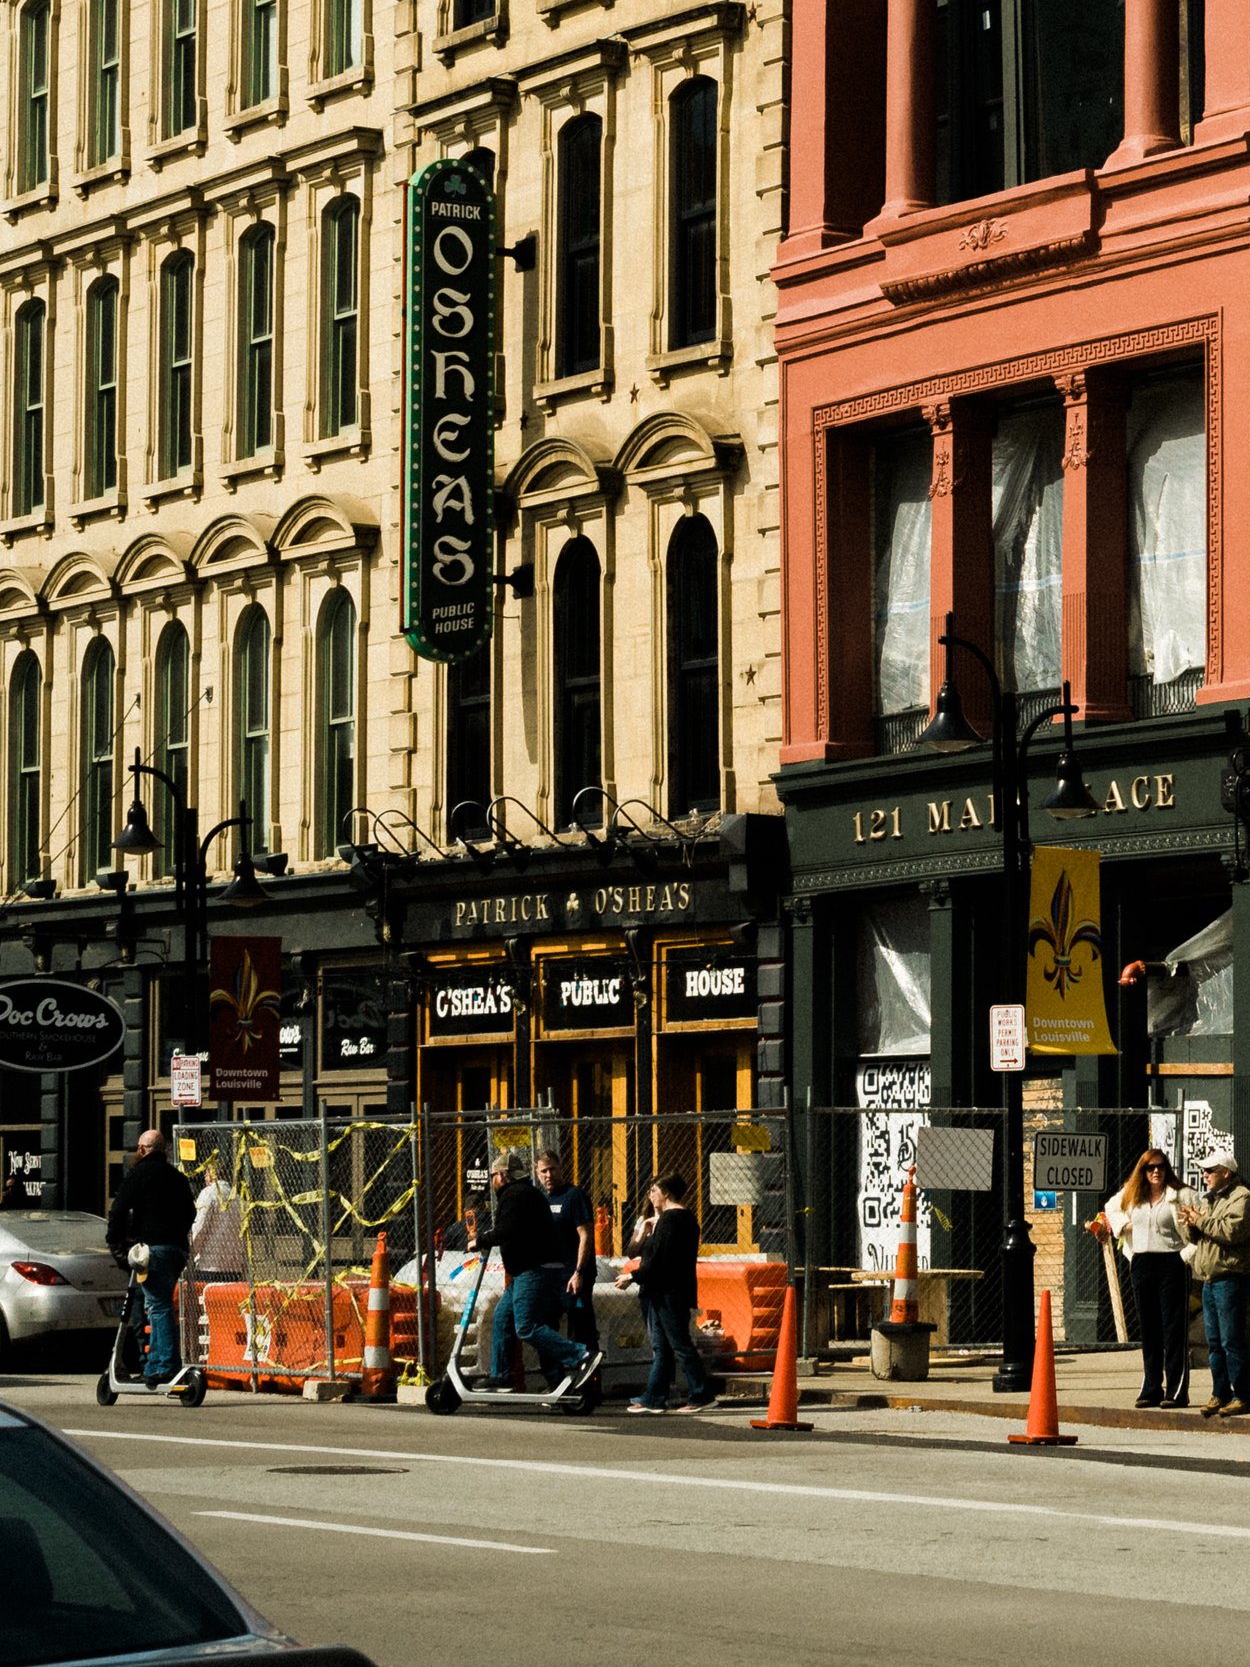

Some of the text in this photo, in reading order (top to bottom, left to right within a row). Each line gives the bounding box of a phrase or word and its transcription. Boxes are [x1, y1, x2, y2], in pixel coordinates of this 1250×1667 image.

[431, 201, 481, 220] PATRICK
[432, 602, 475, 620] PUBLIC
[435, 617, 475, 634] HOUSE
[852, 773, 1176, 843] 121 MAI ACE
[454, 882, 691, 927] PATRICK O'SHEA'S
[685, 967, 745, 998] HOUSE
[560, 977, 620, 1007] PUBLIC
[436, 985, 512, 1018] O'SHEA'S
[996, 1010, 1018, 1018] PUBLIC
[997, 1019, 1018, 1027] WORKS
[1033, 1017, 1095, 1029] Downtown
[997, 1028, 1017, 1037] PERMIT
[1034, 1031, 1091, 1042] Louisville
[996, 1038, 1019, 1047] PARKING
[1000, 1047, 1015, 1057] ONLY
[175, 1071, 198, 1080] LOADING
[215, 1068, 268, 1078] Downtown
[177, 1082, 195, 1091] ZONE
[216, 1079, 262, 1089] Louisville
[1039, 1137, 1102, 1158] SIDEWALK
[1047, 1166, 1094, 1187] CLOSED
